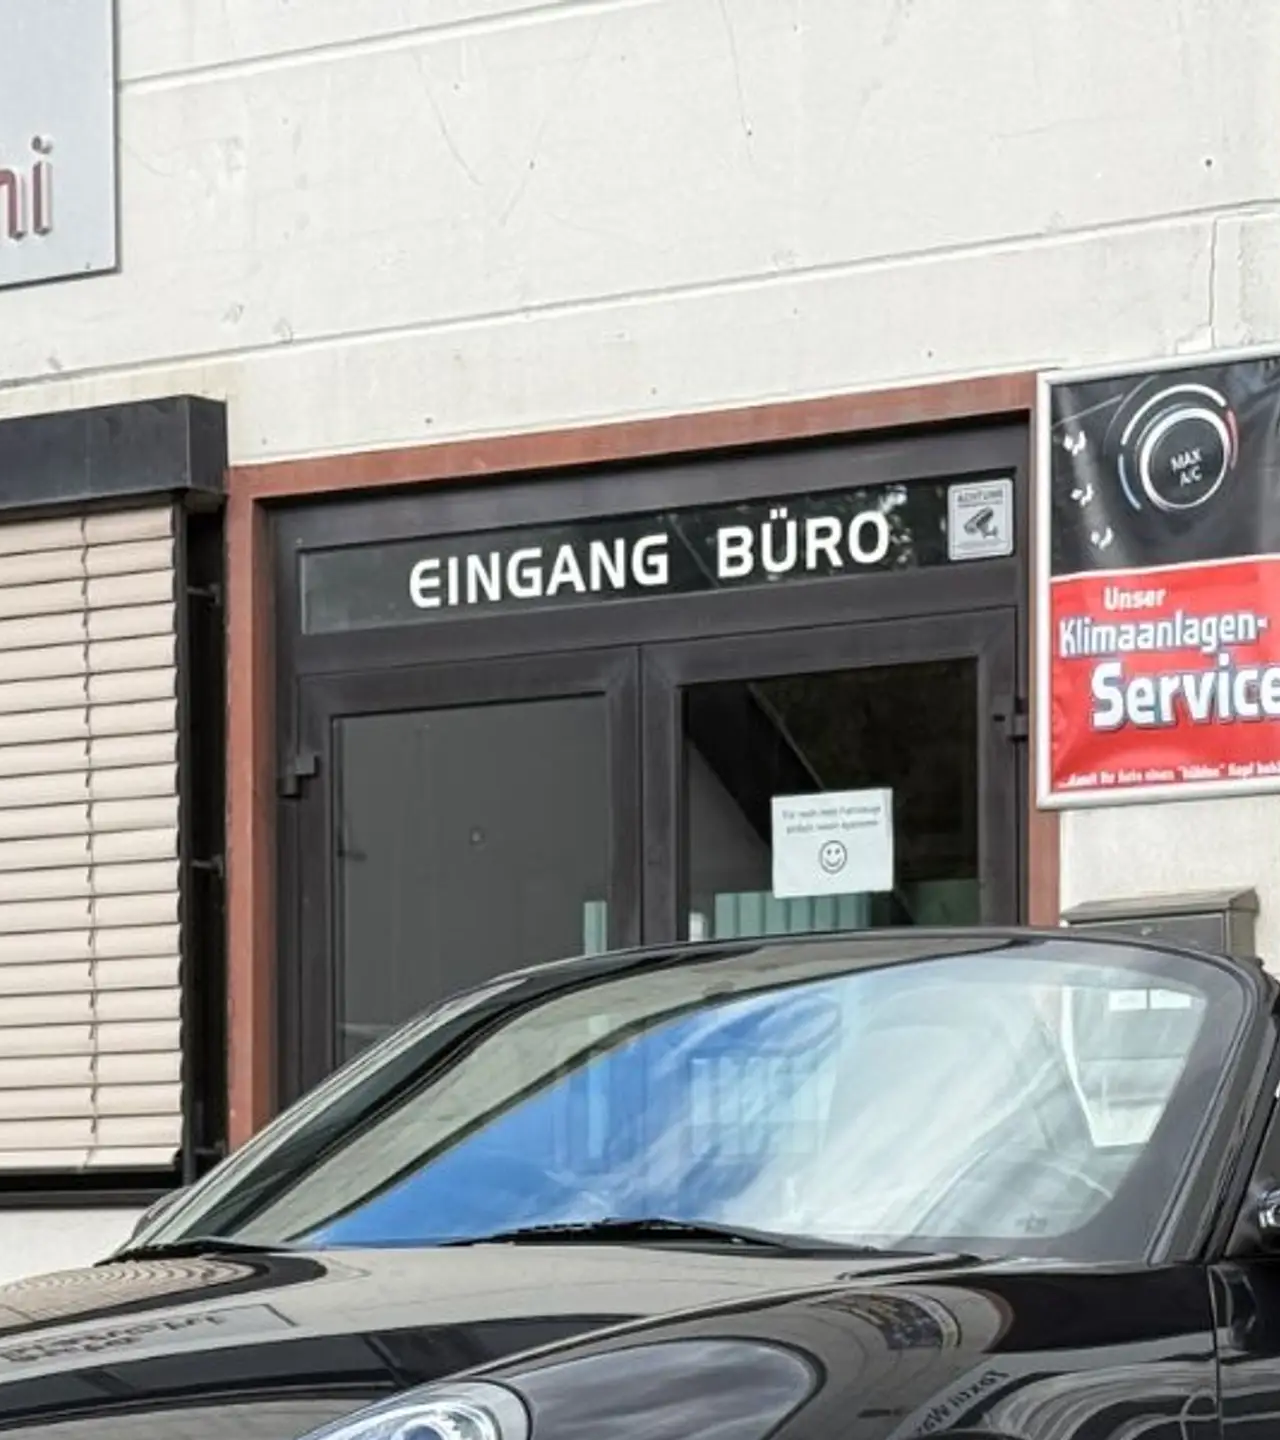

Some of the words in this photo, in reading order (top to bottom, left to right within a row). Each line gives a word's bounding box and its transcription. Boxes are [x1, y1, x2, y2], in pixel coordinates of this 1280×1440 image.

[409, 533, 669, 608] EINGANG
[717, 508, 892, 579] BÜRO
[1103, 586, 1167, 611] Unser
[1059, 609, 1269, 658] Klimaanlagen-
